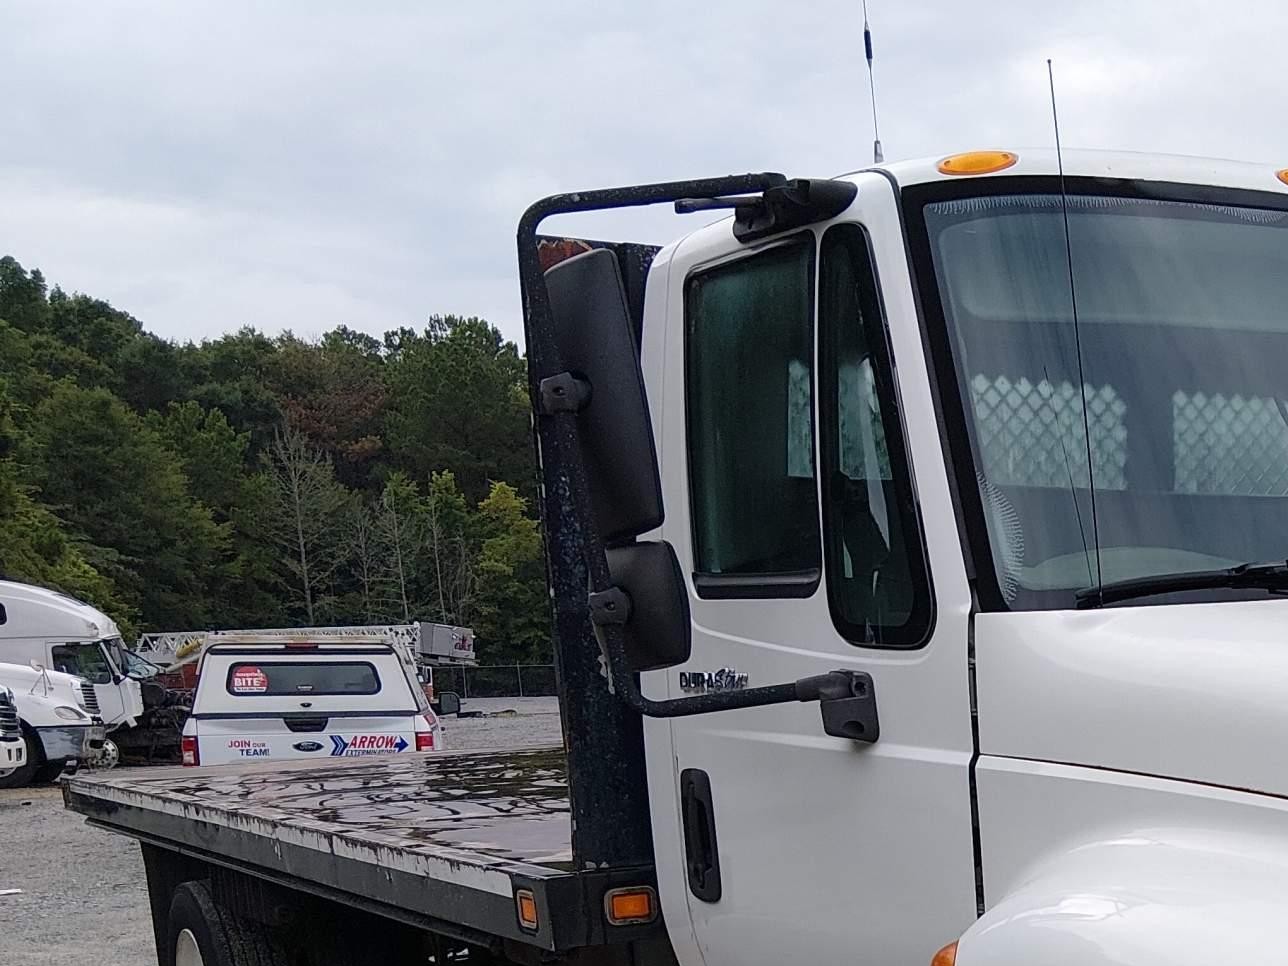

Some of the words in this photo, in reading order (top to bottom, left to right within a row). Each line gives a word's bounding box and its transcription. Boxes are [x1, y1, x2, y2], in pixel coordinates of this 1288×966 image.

[234, 677, 260, 687] BITE
[228, 740, 251, 748] JOIN
[348, 735, 397, 749] ARROW
[240, 749, 270, 757] TEAM!
